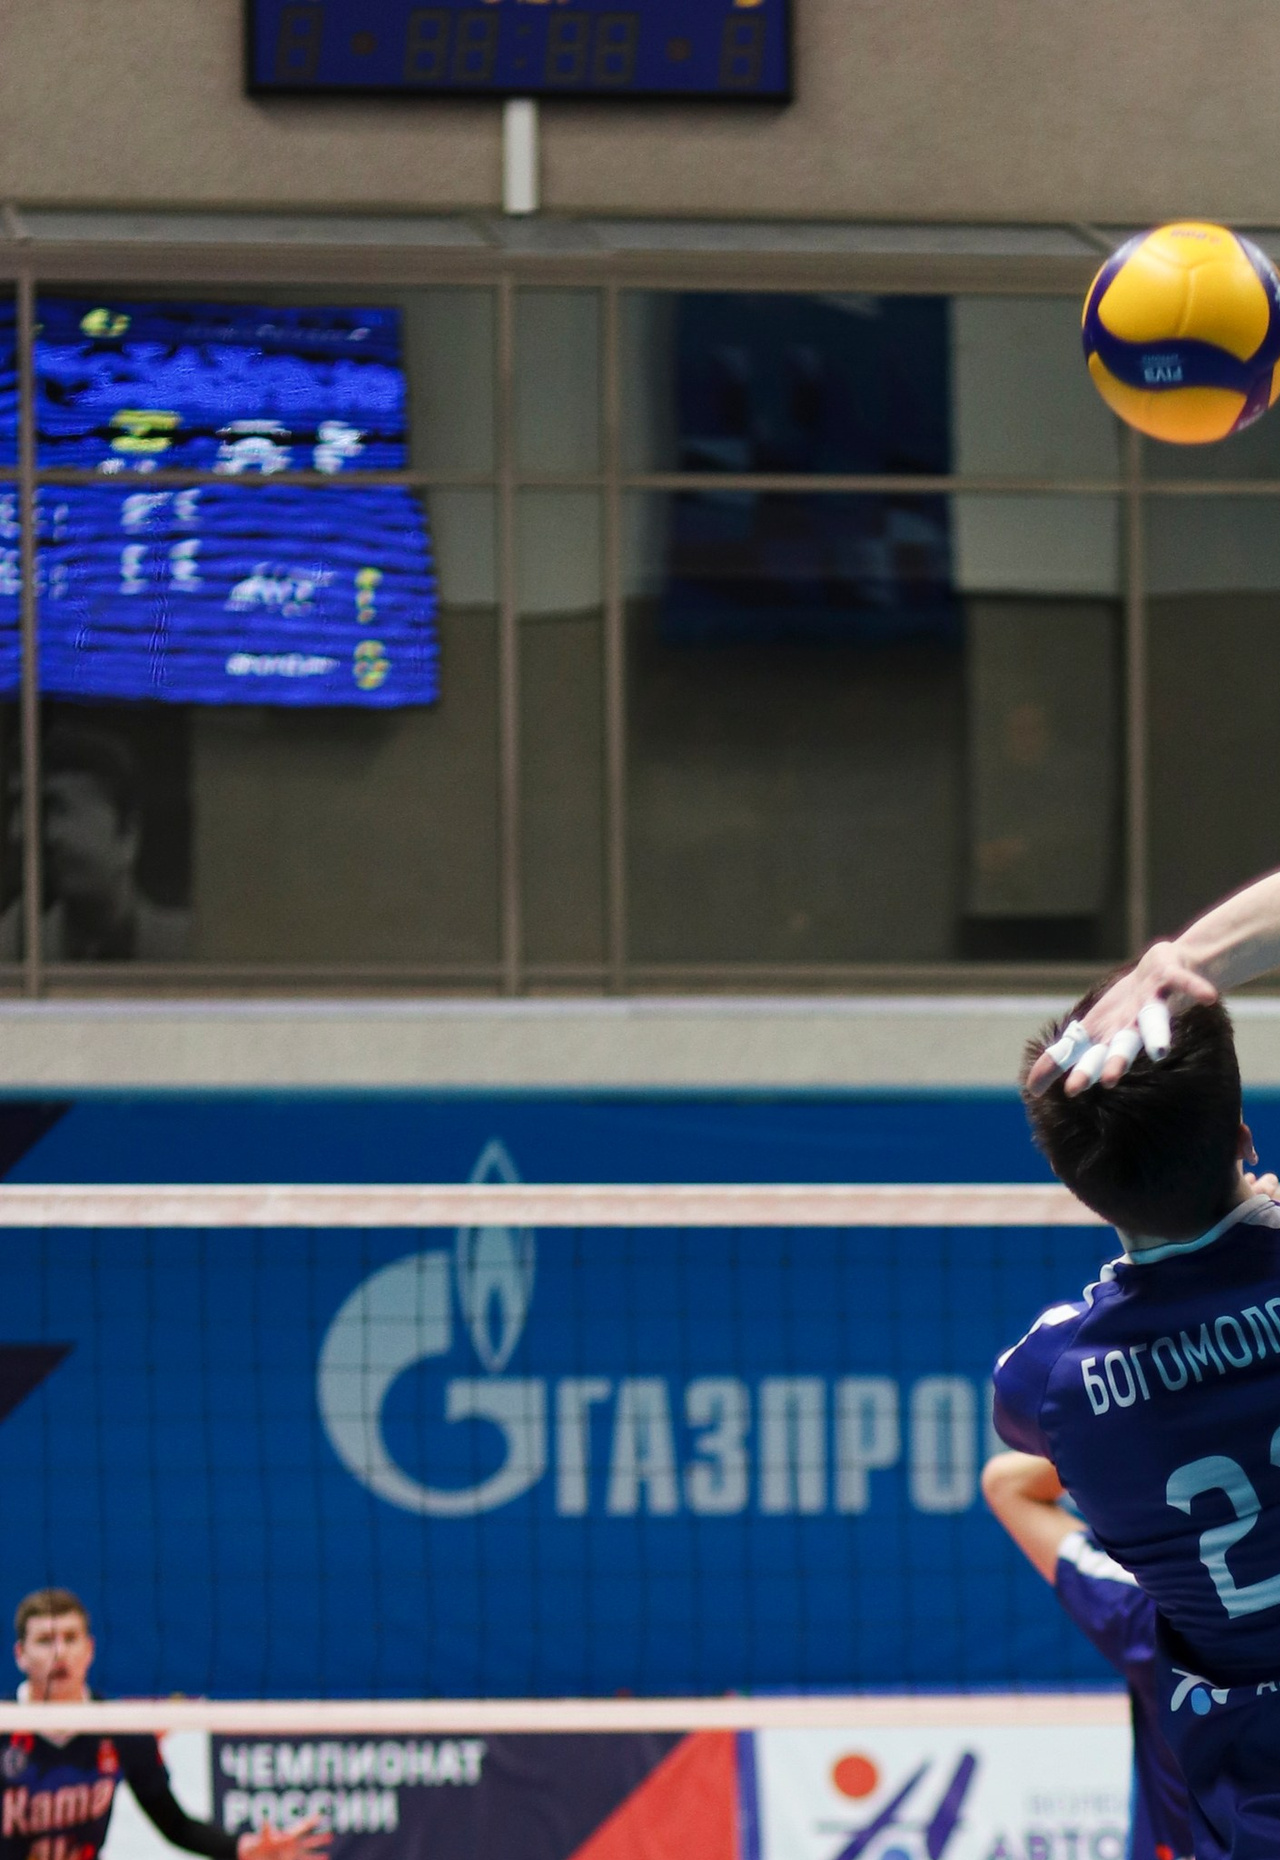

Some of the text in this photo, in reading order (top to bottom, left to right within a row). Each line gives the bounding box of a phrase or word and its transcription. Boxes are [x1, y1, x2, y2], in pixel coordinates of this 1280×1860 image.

[556, 1377, 1006, 1516] ГАЗПРО
[220, 1740, 486, 1788] ЧЕМПИОНАТ
[223, 1789, 398, 1834] РОССИИ
